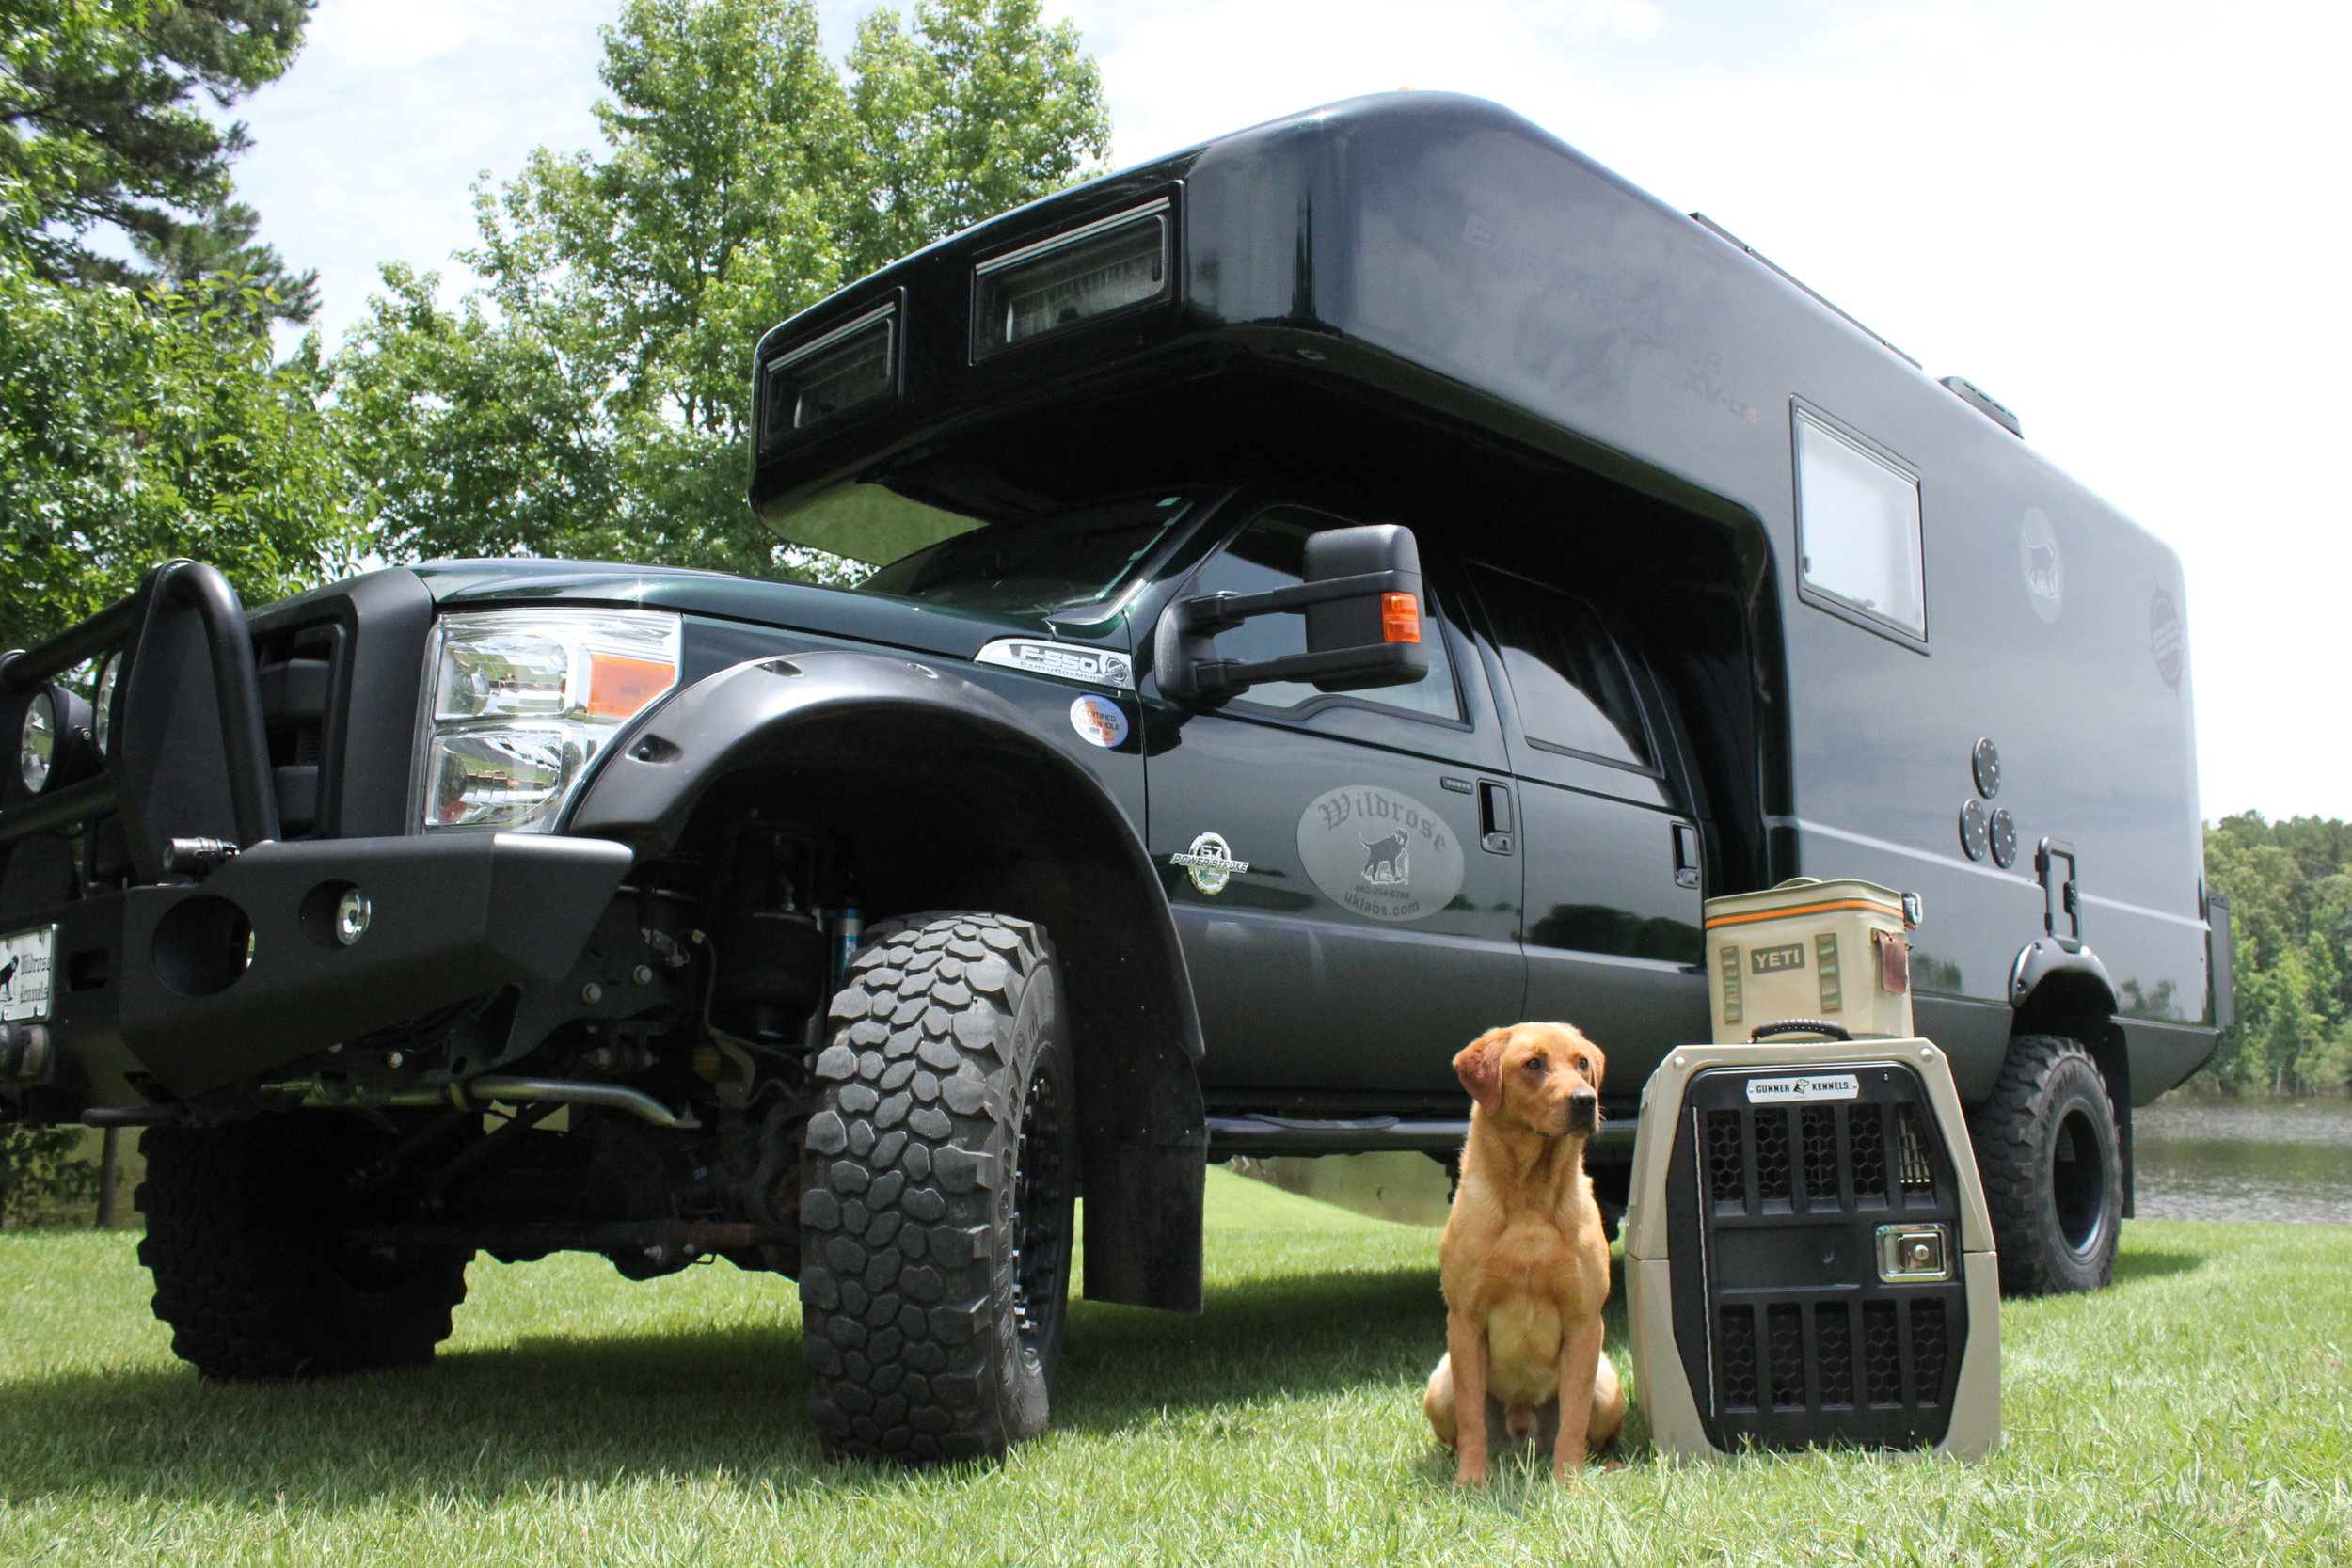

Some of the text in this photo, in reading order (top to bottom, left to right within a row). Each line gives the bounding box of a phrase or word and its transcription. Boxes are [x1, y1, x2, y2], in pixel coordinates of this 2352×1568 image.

[1019, 645, 1098, 674] F-550
[1317, 791, 1446, 853] Wildrose
[1171, 853, 1248, 872] POWER STROKE
[1344, 892, 1420, 916] uklabs.com
[1755, 949, 1801, 969] YETI
[1756, 1082, 1850, 1093] GUNNER KENNELS
